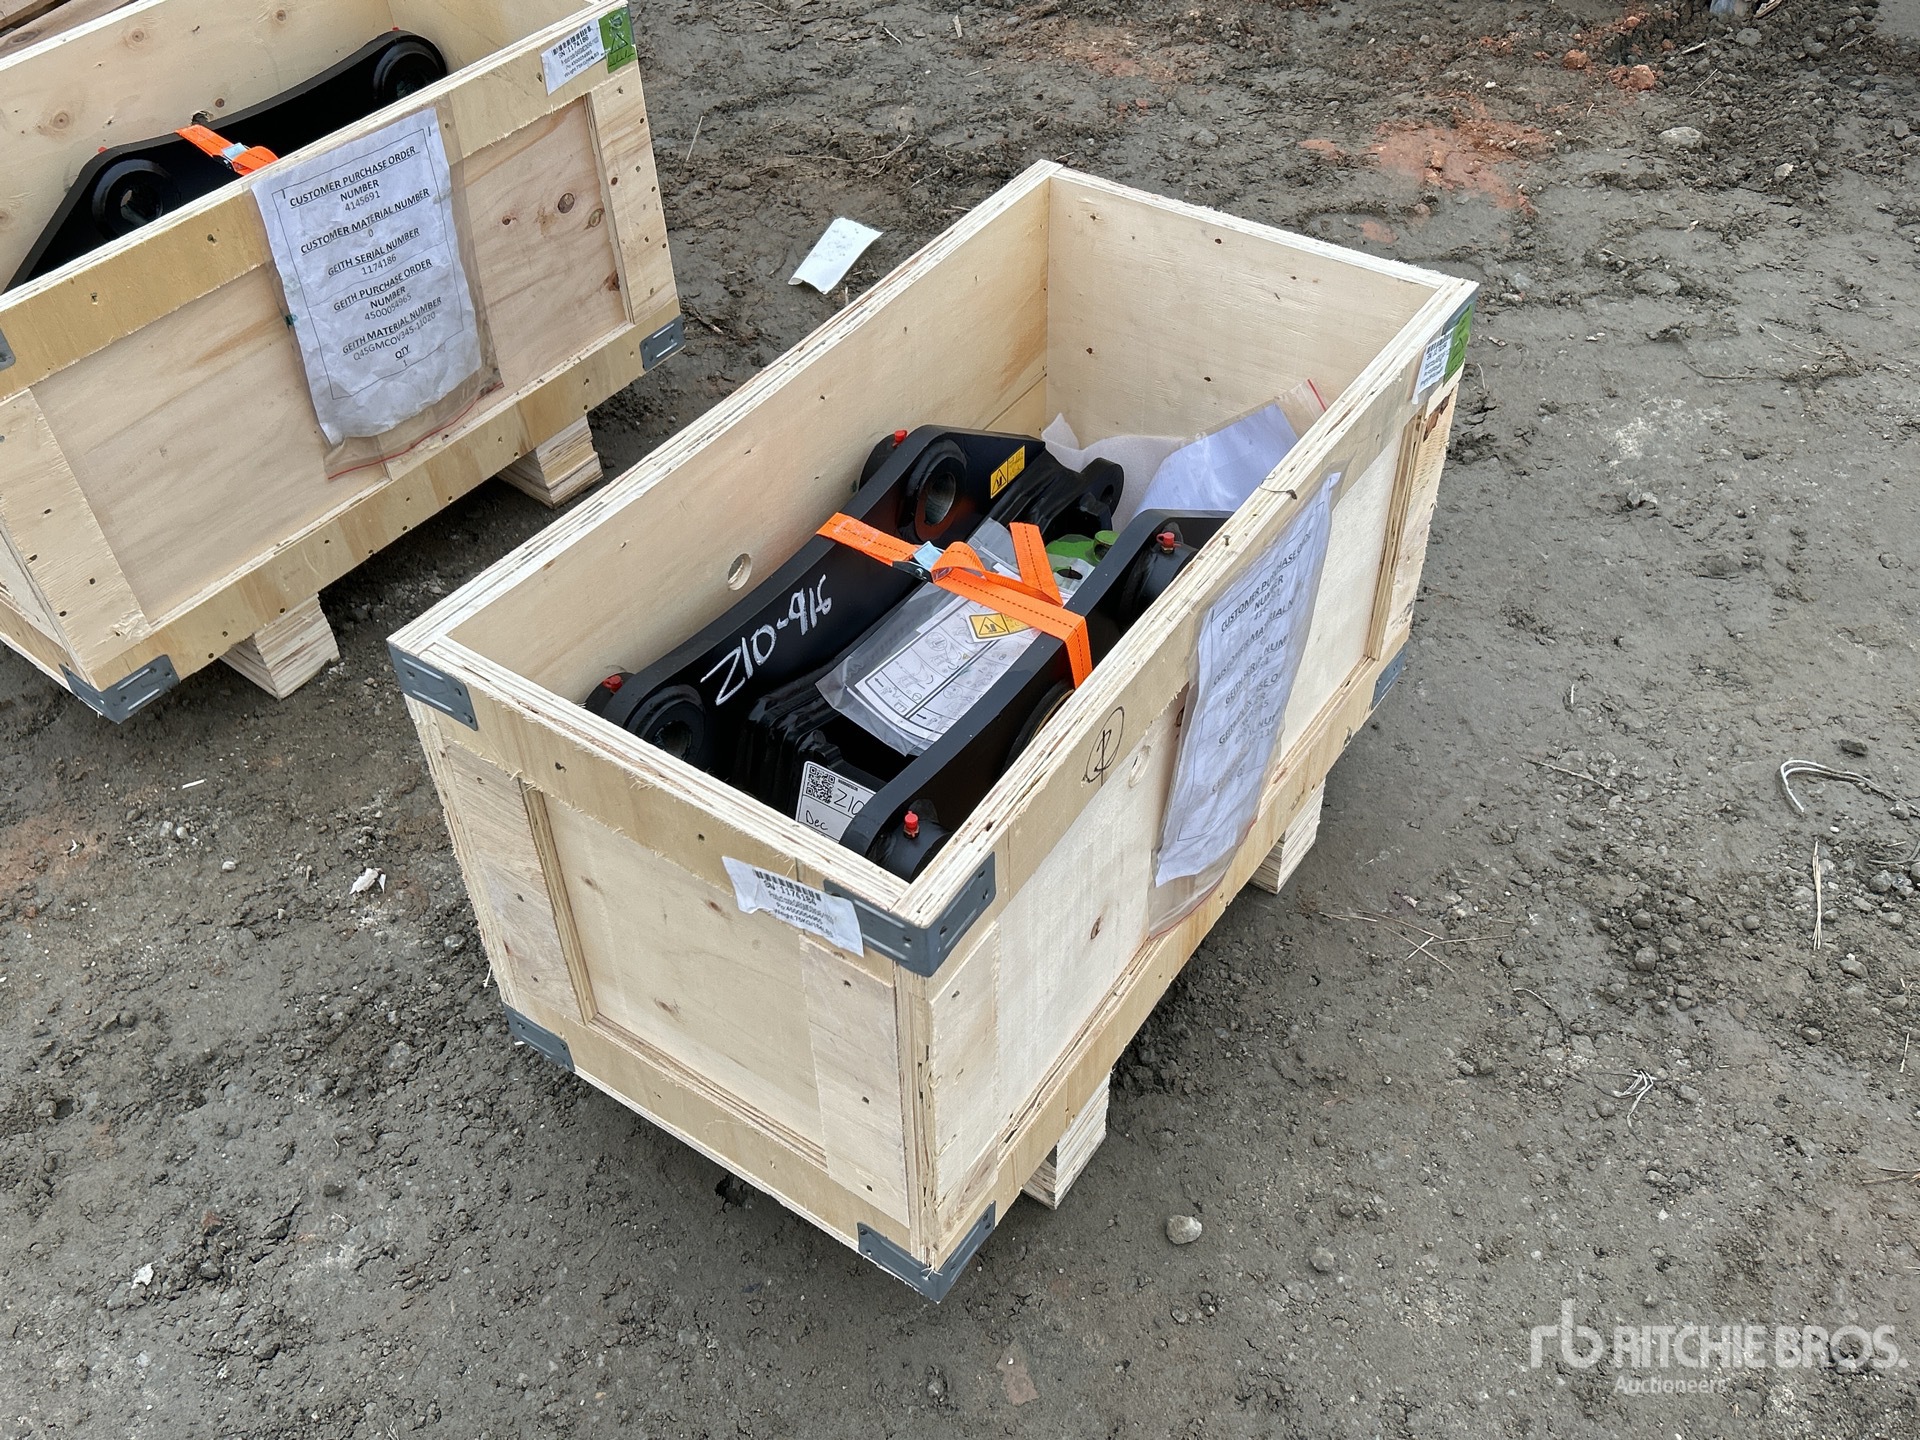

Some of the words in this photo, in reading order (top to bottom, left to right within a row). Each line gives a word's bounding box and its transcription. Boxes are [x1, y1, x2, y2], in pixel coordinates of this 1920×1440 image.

[290, 180, 342, 208] CUSTOMER
[343, 159, 387, 186] PURCHASE
[388, 145, 416, 166] ORDER
[340, 179, 380, 202] NUMBER
[344, 190, 381, 211] 4145691
[300, 226, 350, 255] CUSTOMER
[351, 206, 394, 233] MATERIAL
[394, 188, 431, 213] NUMBER
[367, 229, 374, 238] 0
[328, 258, 353, 277] GEITH
[355, 246, 384, 266] SERIAL
[385, 227, 420, 252] NUMBER
[361, 254, 397, 275] 1174186
[333, 292, 358, 312] GEITH
[359, 273, 403, 297] PURCHASE
[404, 258, 433, 278] ORDER
[370, 286, 406, 309] NUMBER
[364, 293, 412, 321] 4500054965
[342, 337, 366, 355] GEITH
[366, 315, 409, 341] MATERIAL
[409, 296, 442, 320] NUMBER
[394, 345, 411, 361] QTY
[1221, 587, 1261, 634] CUSTOMER
[700, 574, 832, 706] Z10-916
[805, 810, 828, 831] Dec
